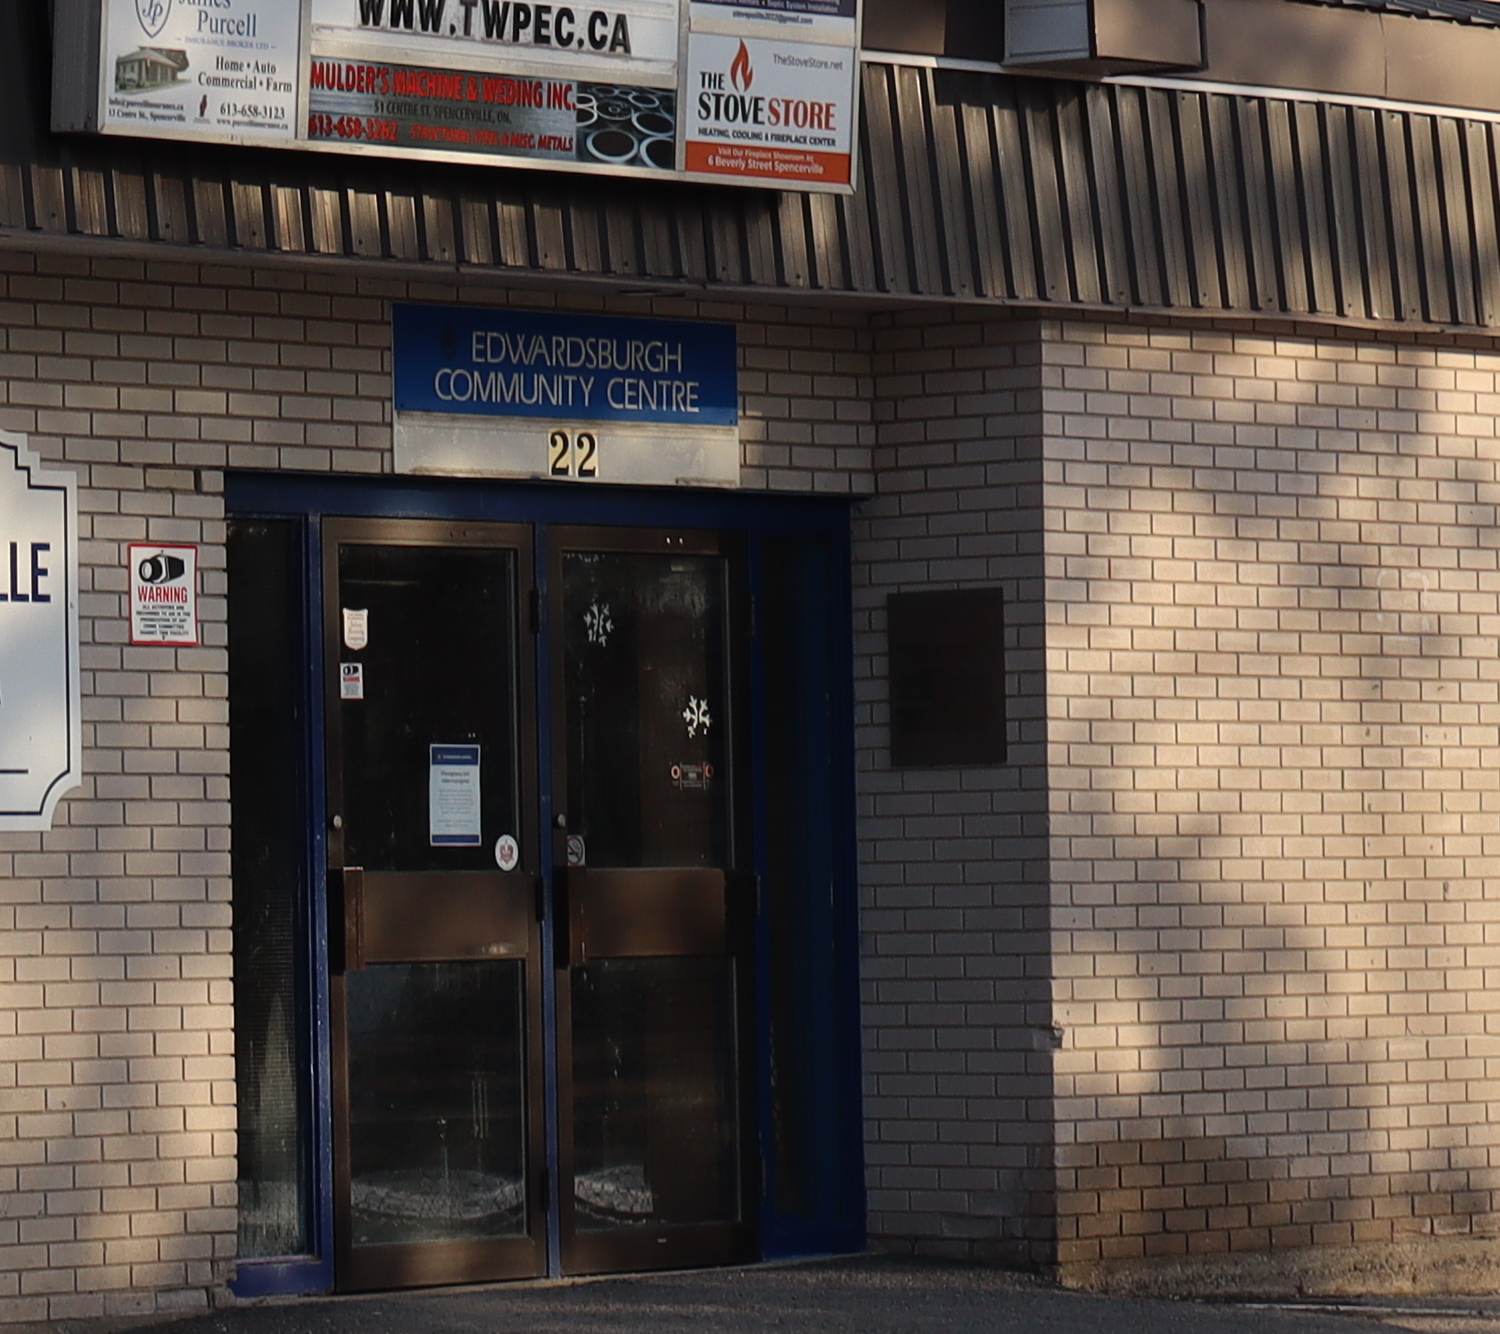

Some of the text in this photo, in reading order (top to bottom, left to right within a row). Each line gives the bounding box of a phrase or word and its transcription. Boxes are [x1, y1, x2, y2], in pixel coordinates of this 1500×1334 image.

[197, 9, 257, 38] Purcell
[216, 55, 277, 75] Home Auto
[773, 53, 844, 71] TheStoveStore.net
[198, 72, 292, 94] Commercial Farm
[311, 61, 390, 94] MULDER'S
[393, 69, 464, 101] MACHINE
[467, 76, 479, 102] &
[547, 81, 577, 111] INC.
[700, 71, 725, 91] THE
[220, 102, 285, 120] 613-658-3123
[698, 92, 837, 131] STOVE STORE
[538, 134, 574, 152] METALS
[732, 130, 763, 142] COOLING
[770, 133, 808, 145] FIREPLACE
[809, 136, 836, 147] CENTER
[708, 155, 824, 175] 6 Beverly Street Spencerville
[472, 331, 683, 373] EDWARDSBURGH
[434, 368, 700, 414] COMMUNITY CENTRE
[550, 429, 597, 478] 22
[138, 585, 188, 603] WARNING
